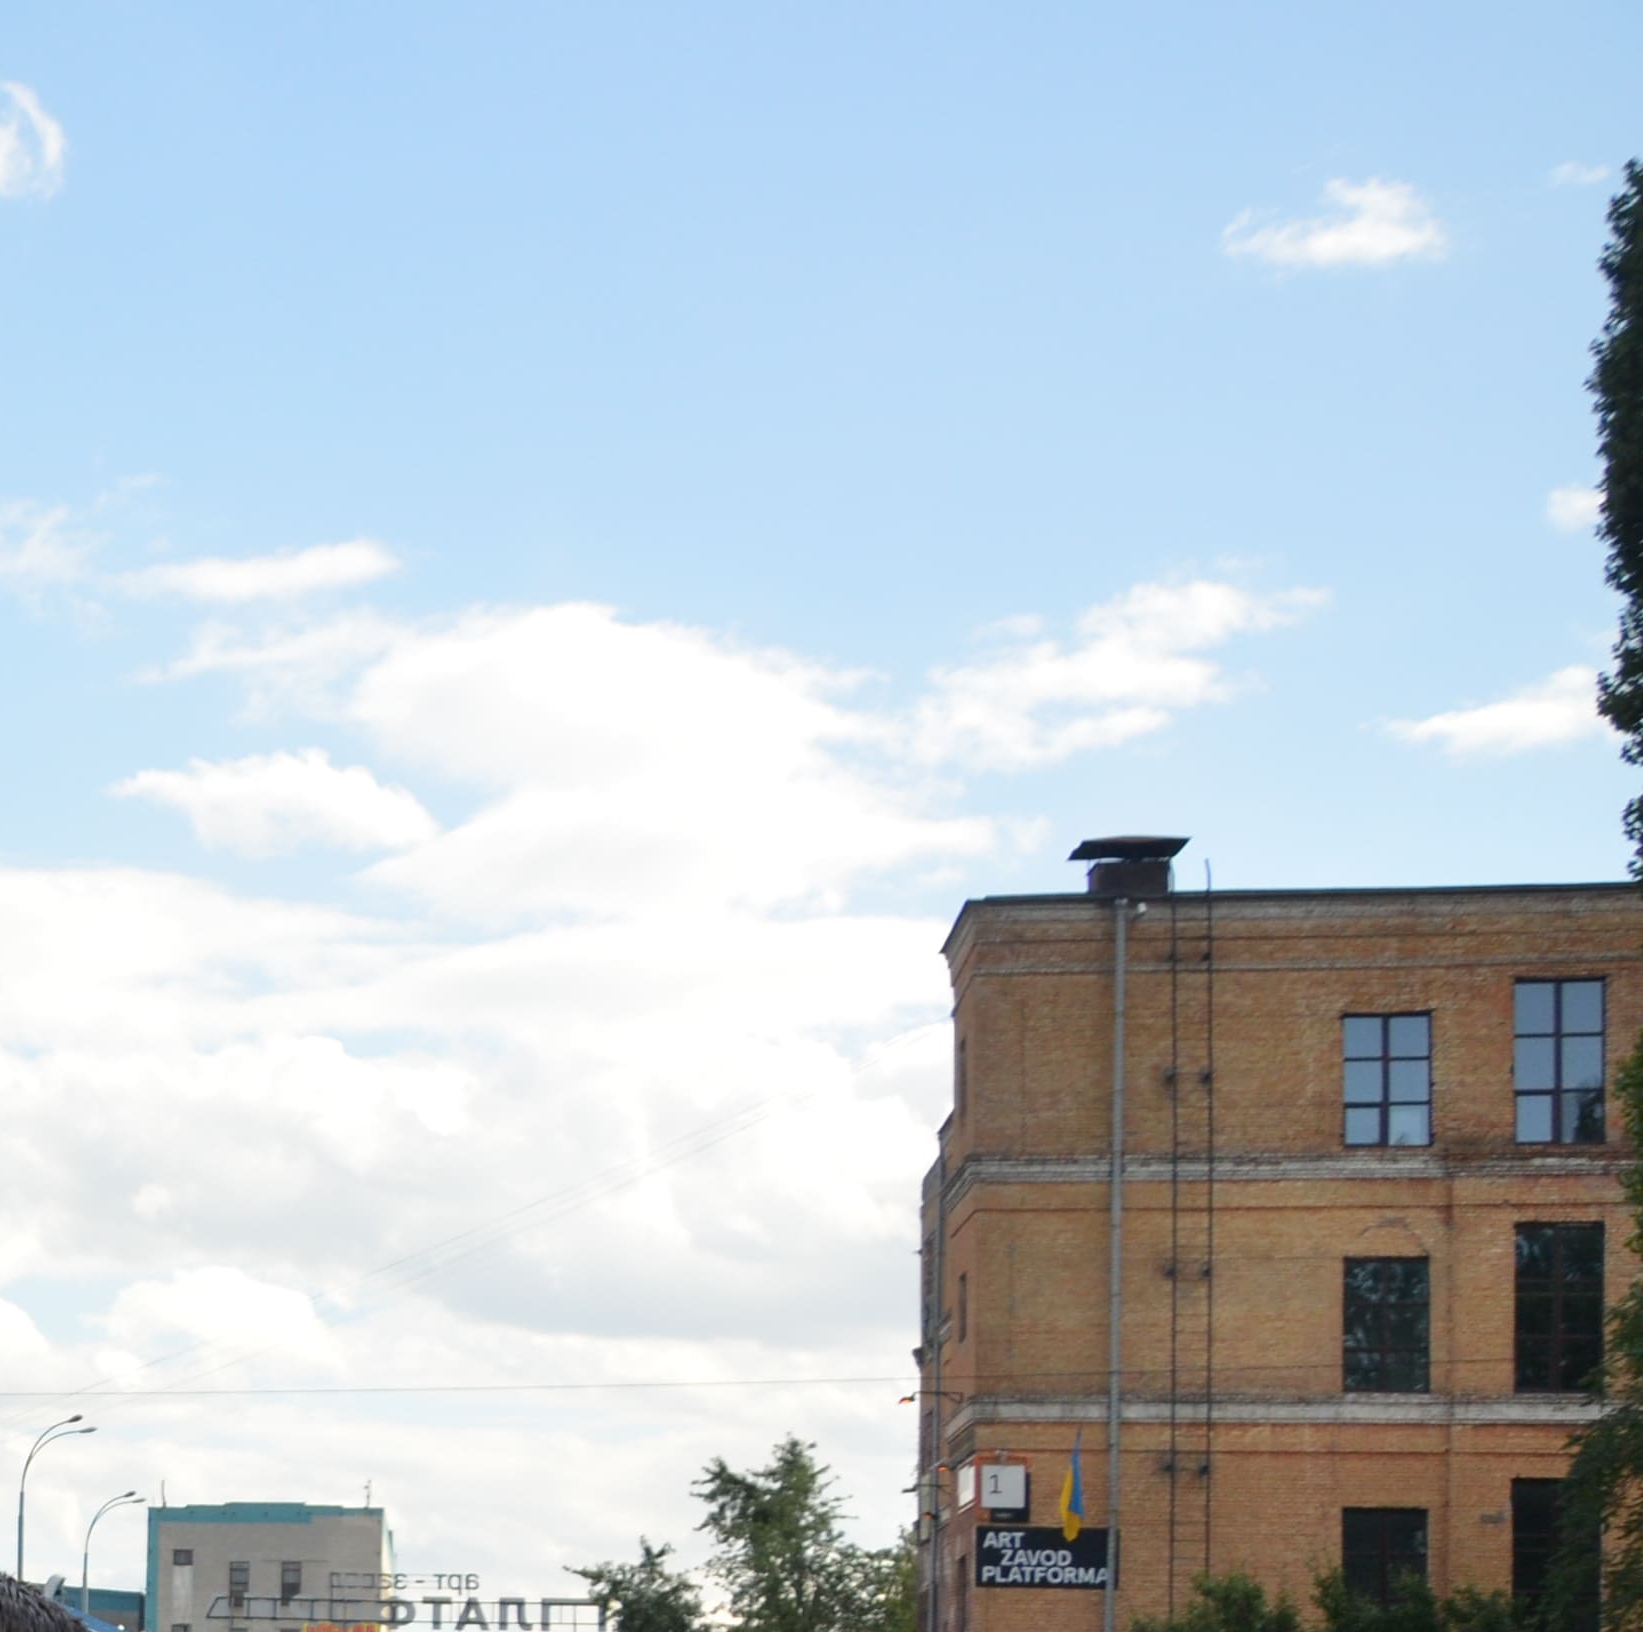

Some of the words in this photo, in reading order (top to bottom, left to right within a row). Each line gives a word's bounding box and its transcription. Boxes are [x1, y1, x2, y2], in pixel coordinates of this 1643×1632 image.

[988, 1473, 1003, 1494] 1
[982, 1531, 1026, 1549] ART
[1000, 1549, 1073, 1566] ZAVOD
[981, 1565, 1109, 1584] PLATFORMA
